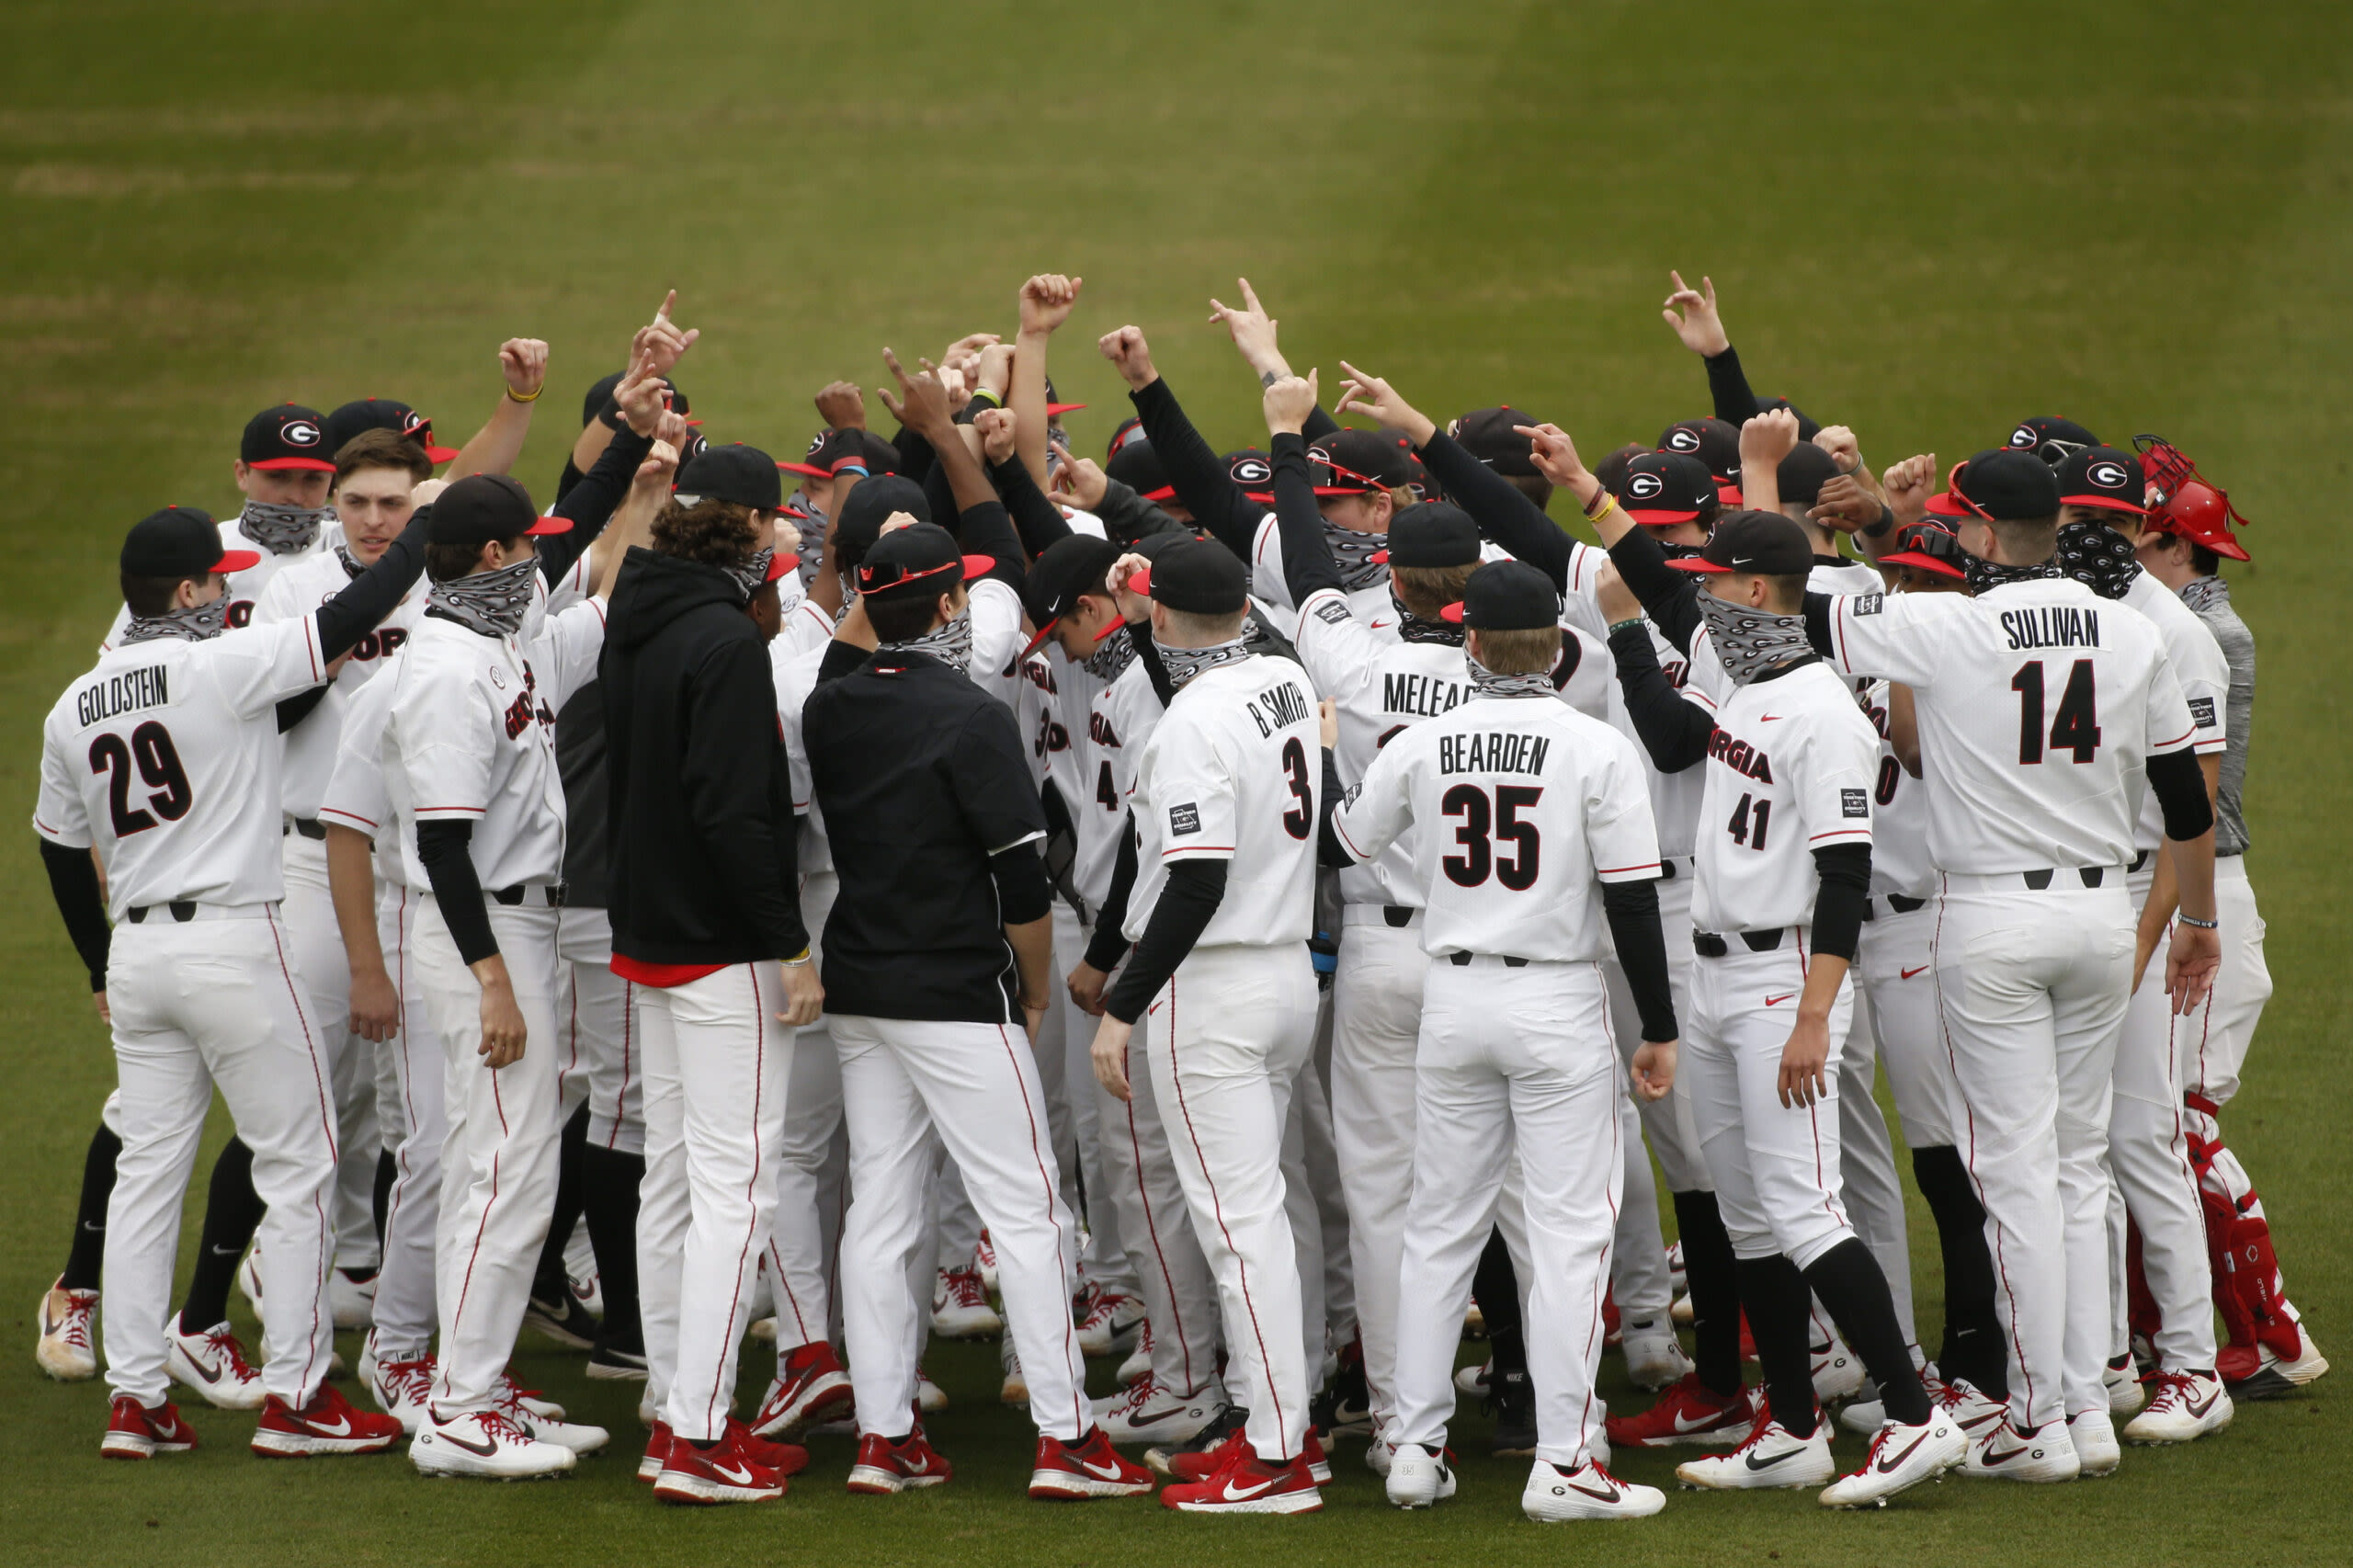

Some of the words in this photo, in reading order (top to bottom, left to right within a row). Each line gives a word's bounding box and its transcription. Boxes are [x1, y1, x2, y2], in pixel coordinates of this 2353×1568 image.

[1999, 608, 2100, 650] SULLIVAN
[77, 664, 169, 728] GOLDSTEIN
[1245, 701, 1273, 740] B.
[1259, 681, 1309, 730] SMITH
[2011, 659, 2102, 765] 14
[88, 720, 193, 839] 29
[1439, 733, 1551, 777] BEARDEN
[1281, 735, 1313, 841] 3
[1441, 783, 1545, 892] 35
[1727, 792, 1772, 851] 41
[1506, 1372, 1523, 1382] NIKE
[1935, 1426, 1948, 1439] G
[2030, 1449, 2044, 1460] G
[1552, 1485, 1566, 1496] G
